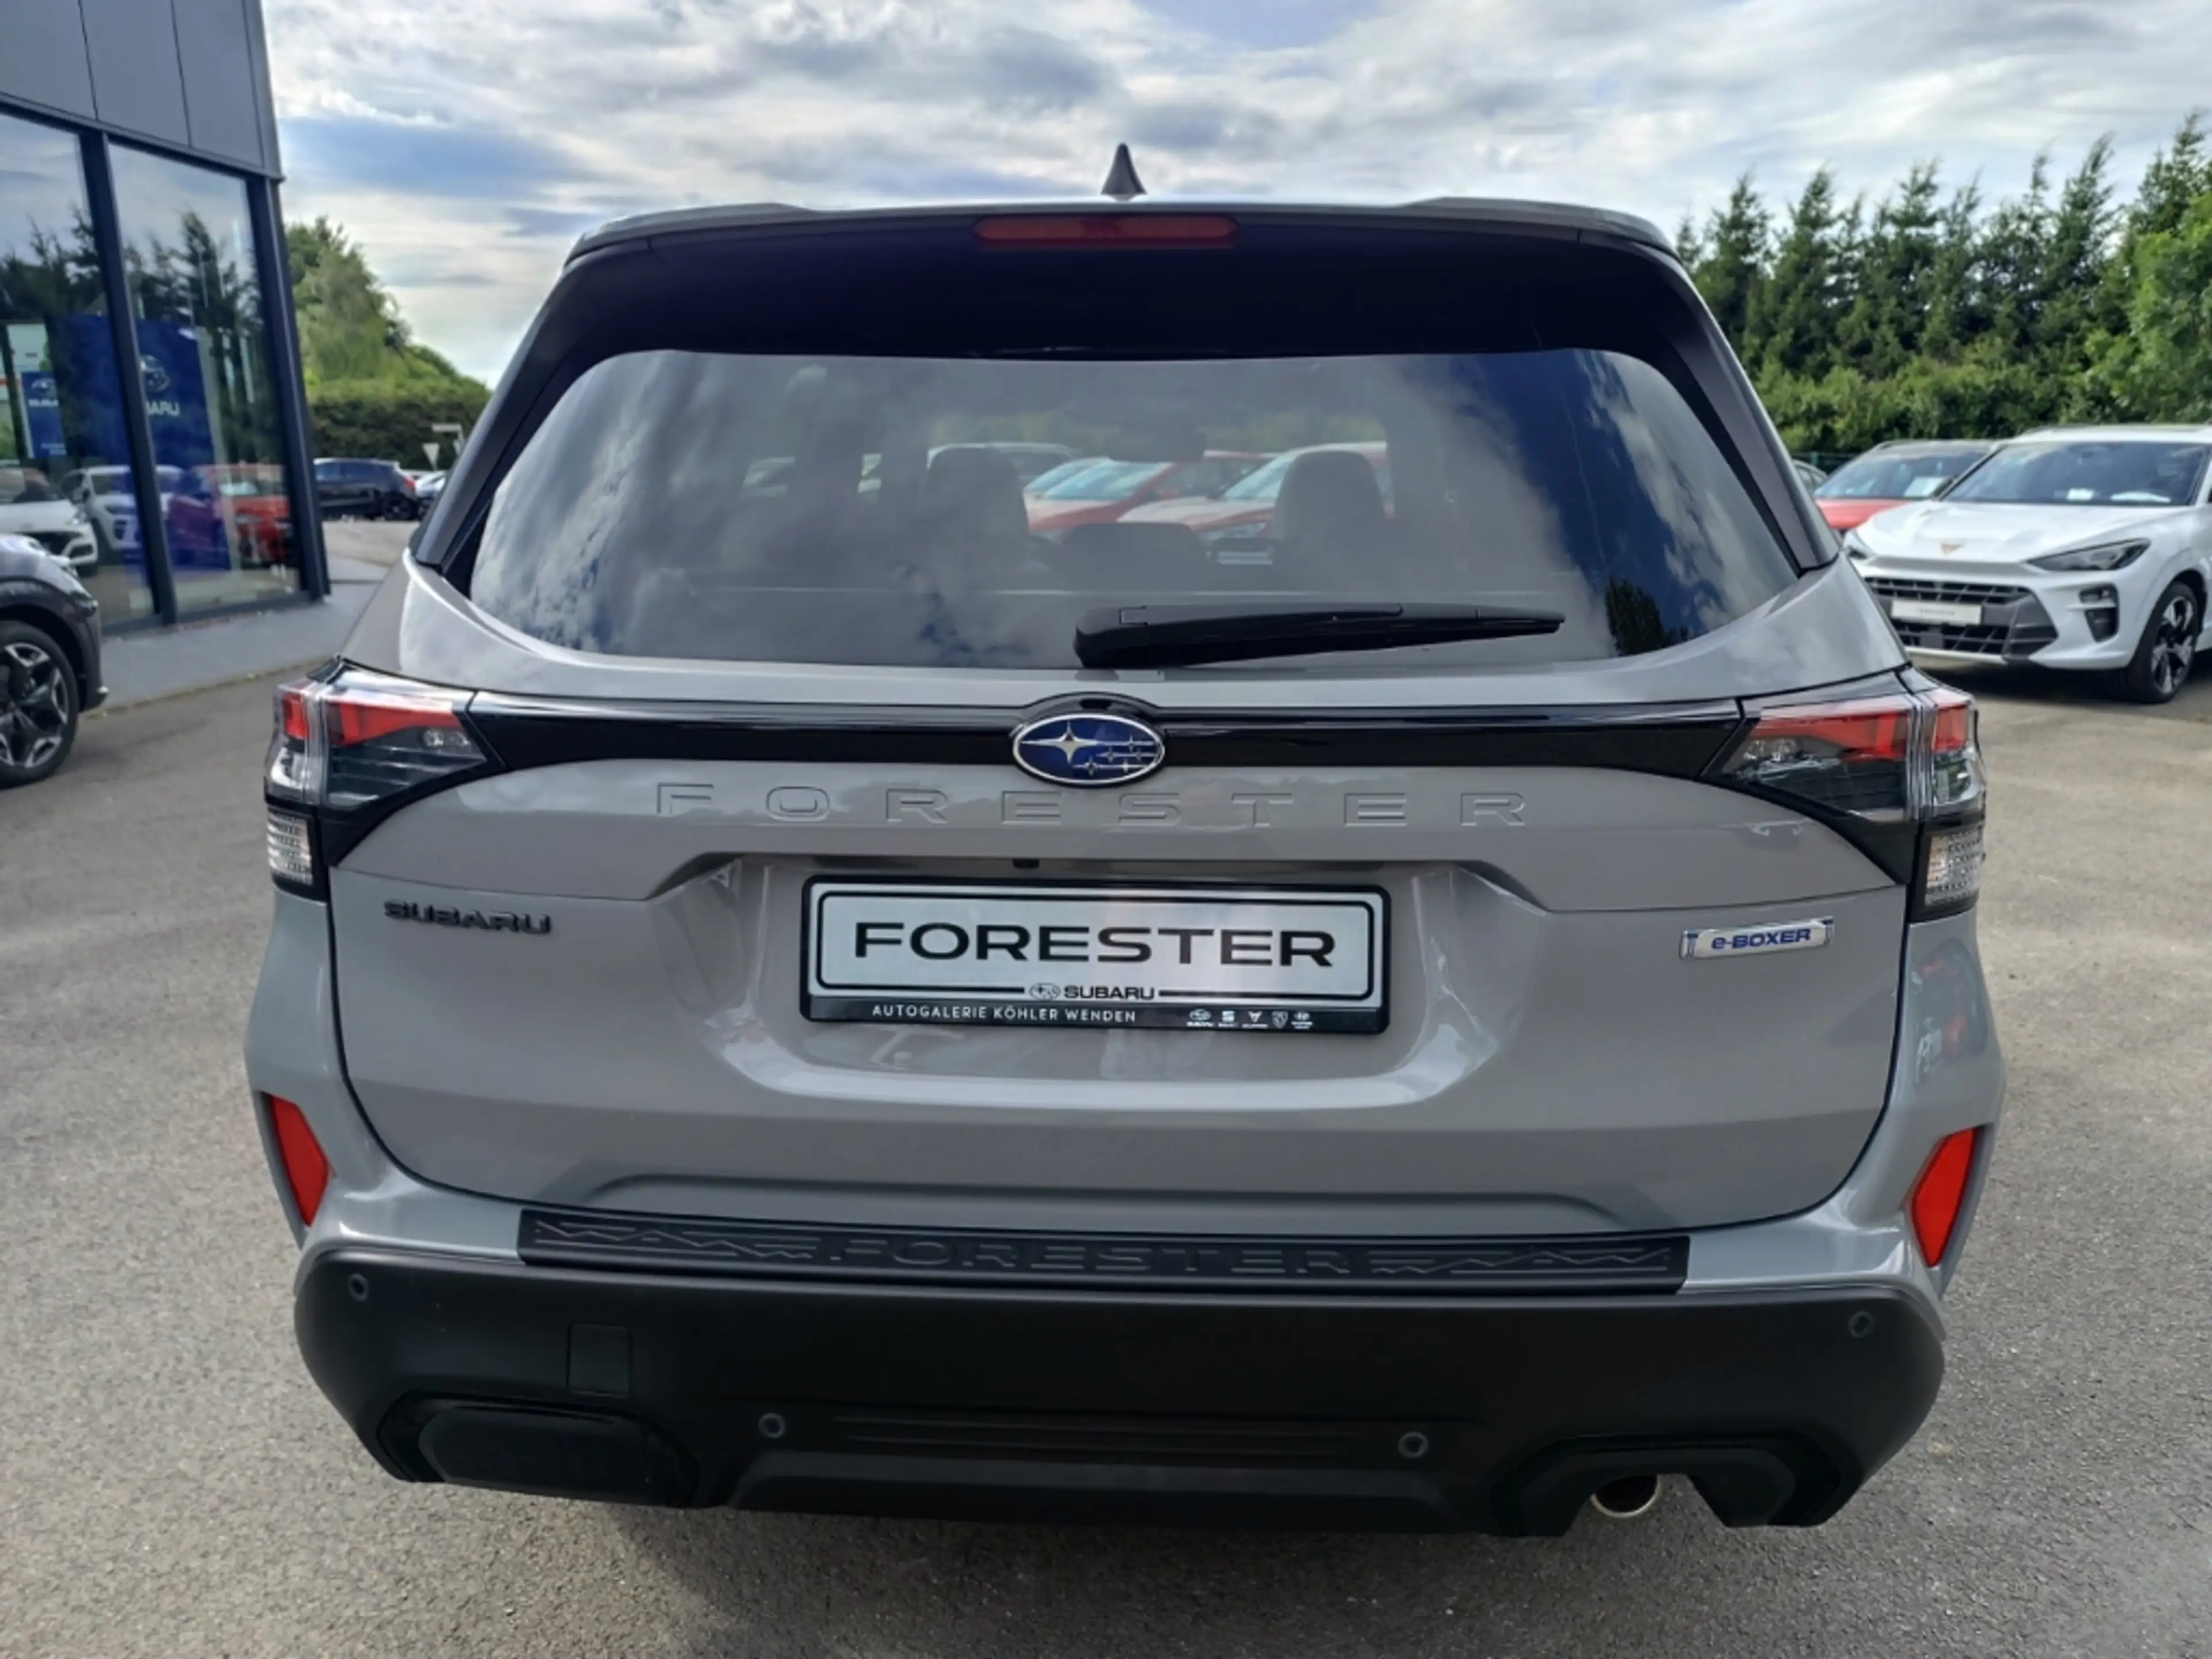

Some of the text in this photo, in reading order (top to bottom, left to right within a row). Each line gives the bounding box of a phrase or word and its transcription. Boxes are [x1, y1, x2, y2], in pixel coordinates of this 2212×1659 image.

[657, 781, 1527, 827] FORESTER
[384, 900, 551, 935] SUBARU
[855, 922, 1335, 967] FORESTER
[1711, 929, 1810, 950] e-BOXER
[1064, 984, 1155, 1001] SUBARU
[872, 1004, 1137, 1023] AUTOGALERIE KÖHLER WENDEN
[830, 1240, 1351, 1274] FORESTER
